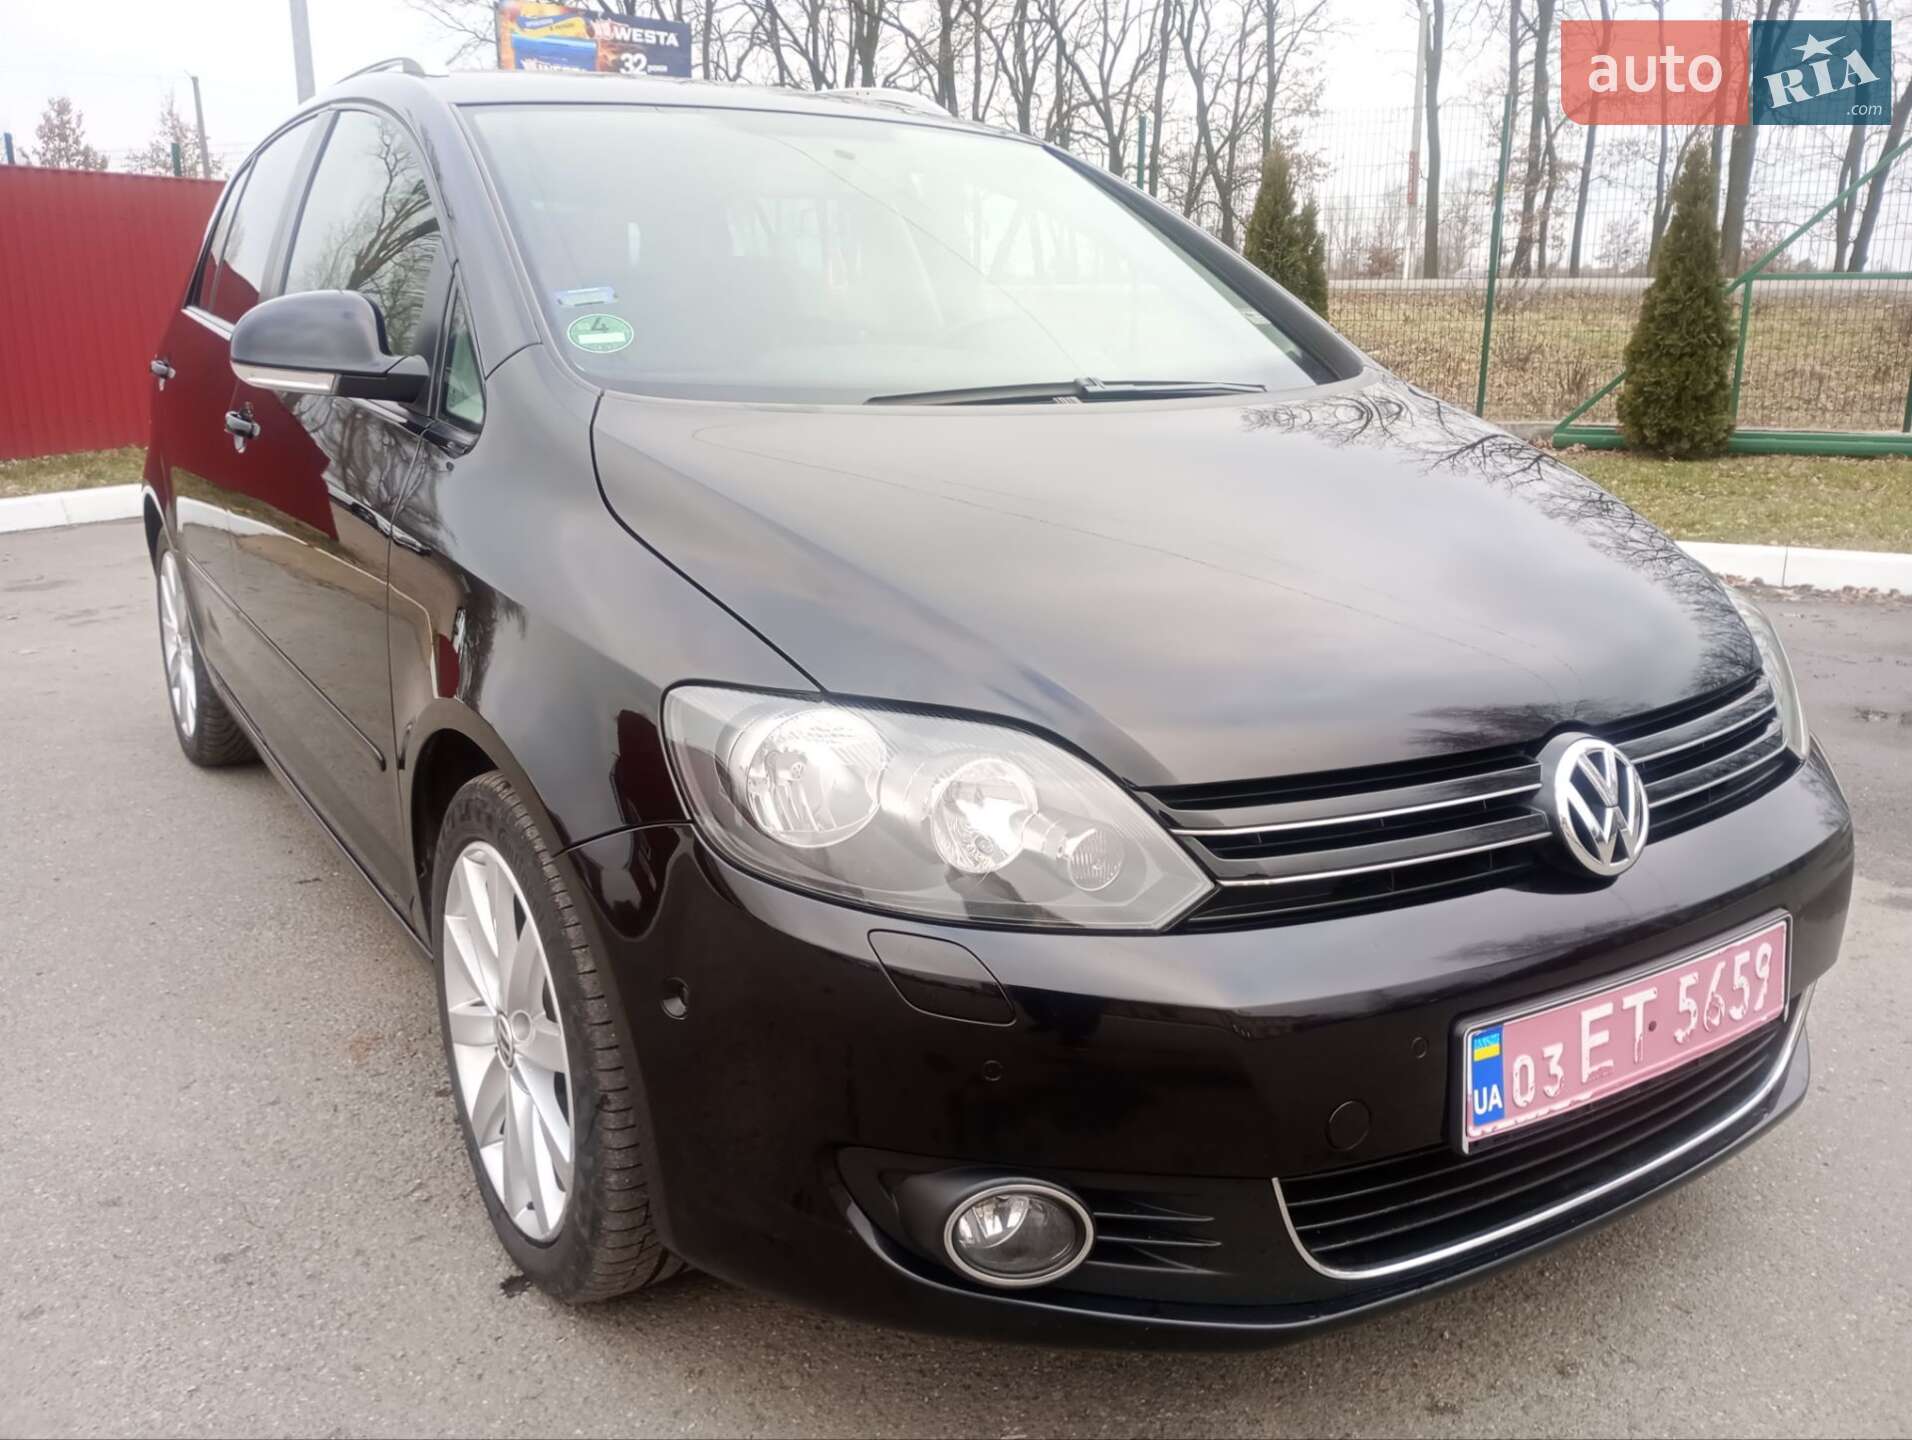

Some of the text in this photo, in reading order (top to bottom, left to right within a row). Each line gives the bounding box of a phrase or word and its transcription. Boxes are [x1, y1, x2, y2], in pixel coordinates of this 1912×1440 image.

[612, 26, 679, 47] WESTA
[619, 52, 648, 75] 32
[1512, 942, 1773, 1107] 03 ET 5659
[1473, 1084, 1503, 1115] UA
